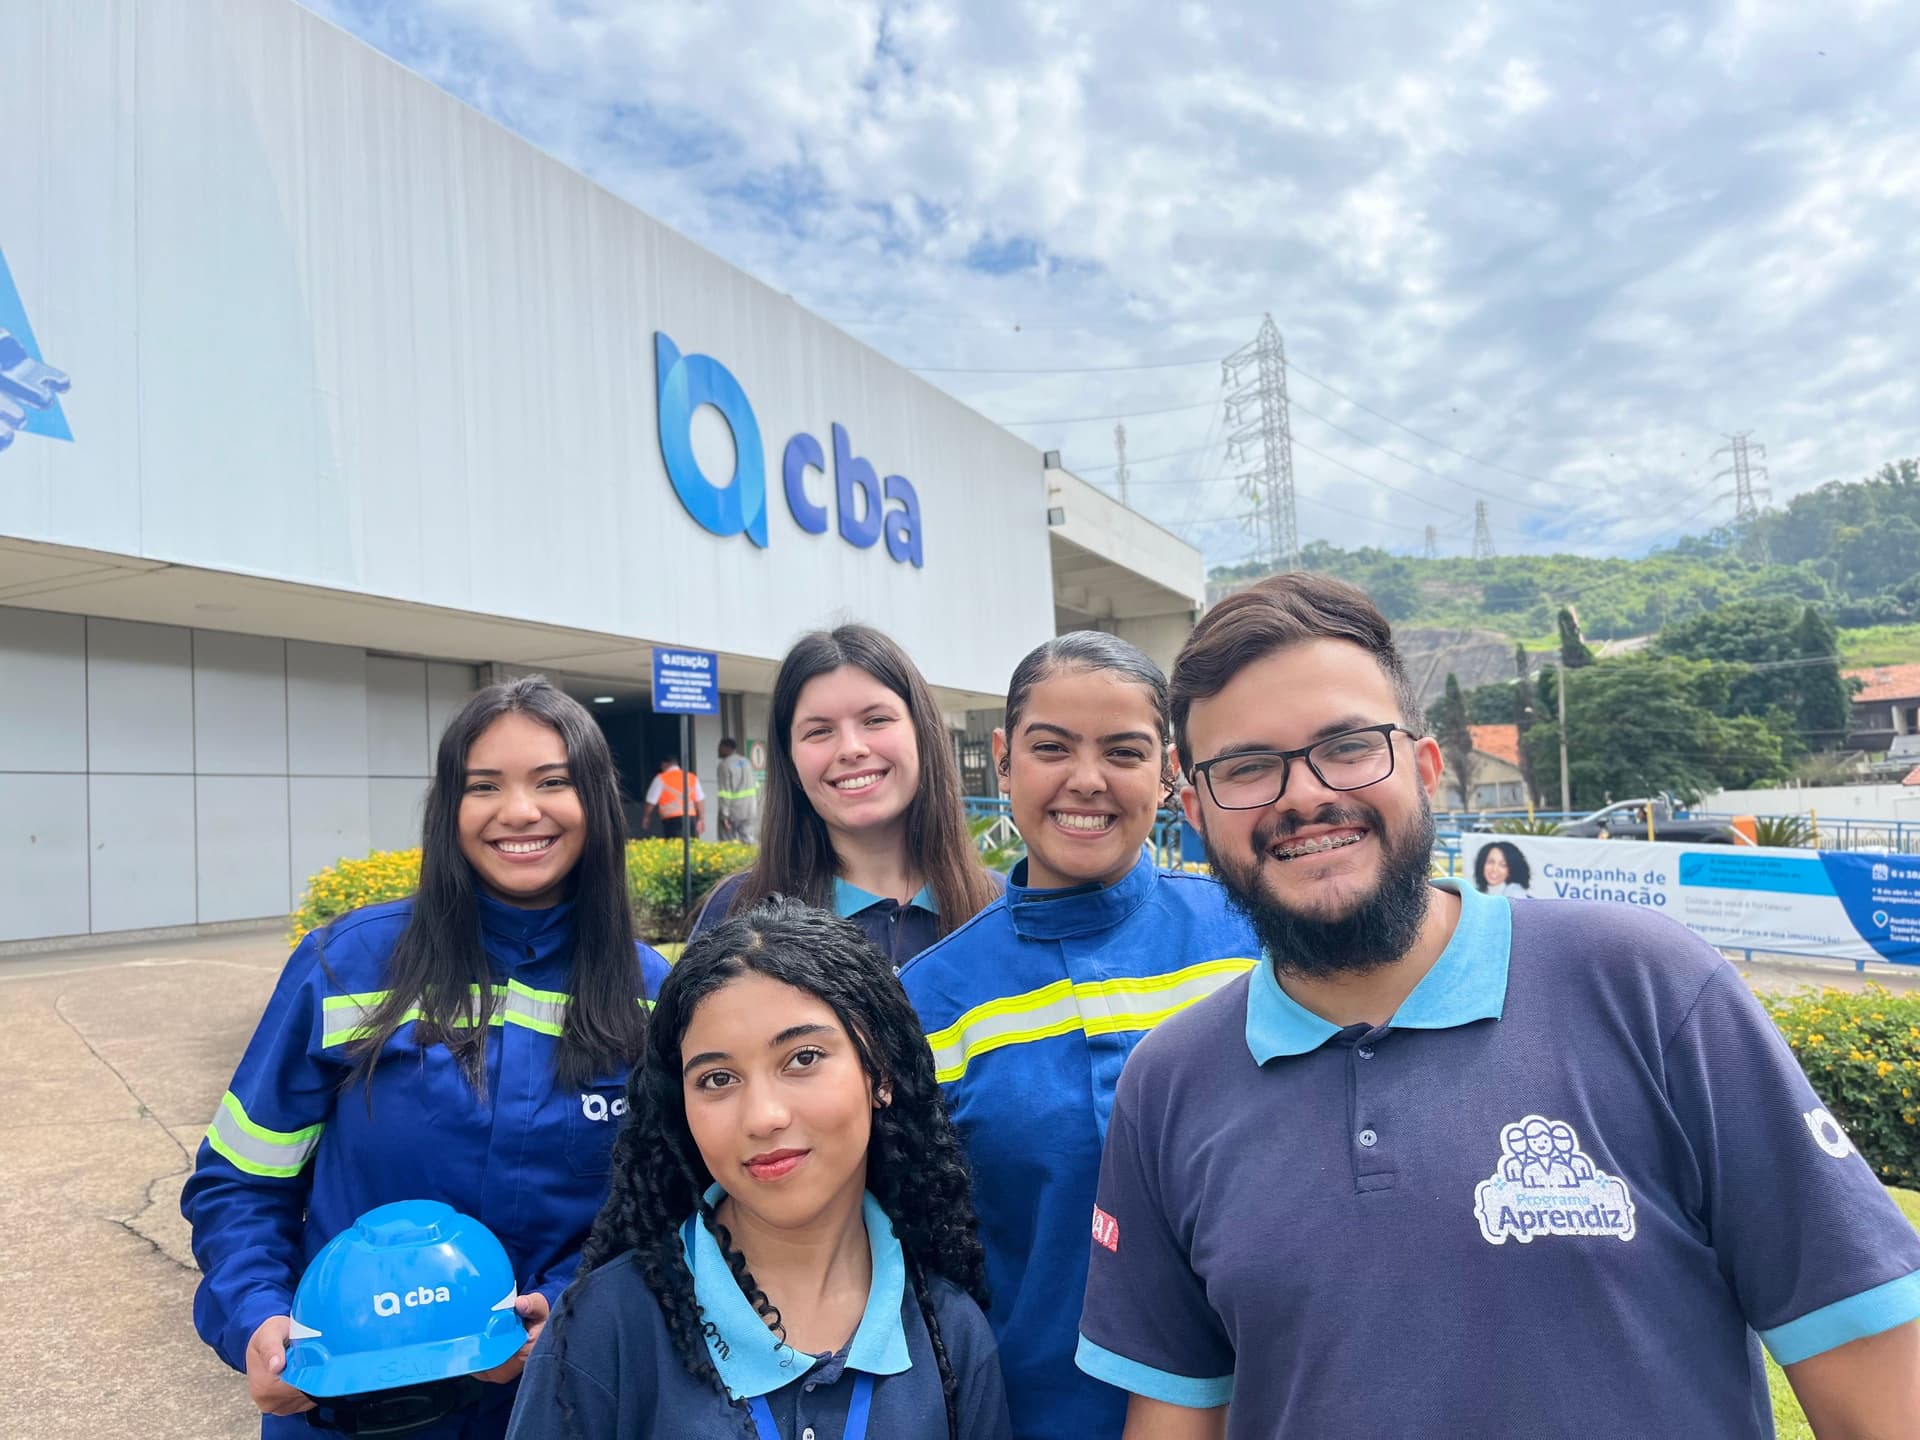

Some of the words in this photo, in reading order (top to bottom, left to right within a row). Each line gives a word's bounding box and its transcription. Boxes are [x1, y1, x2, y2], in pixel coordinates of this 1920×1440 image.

[782, 421, 923, 569] cba
[671, 654, 710, 670] ATENÇÃO
[1543, 864, 1636, 883] Campanha
[1643, 870, 1666, 885] de
[1516, 1193, 1591, 1208] Programa
[1499, 1203, 1624, 1235] Aprendiz
[404, 1286, 450, 1308] cba
